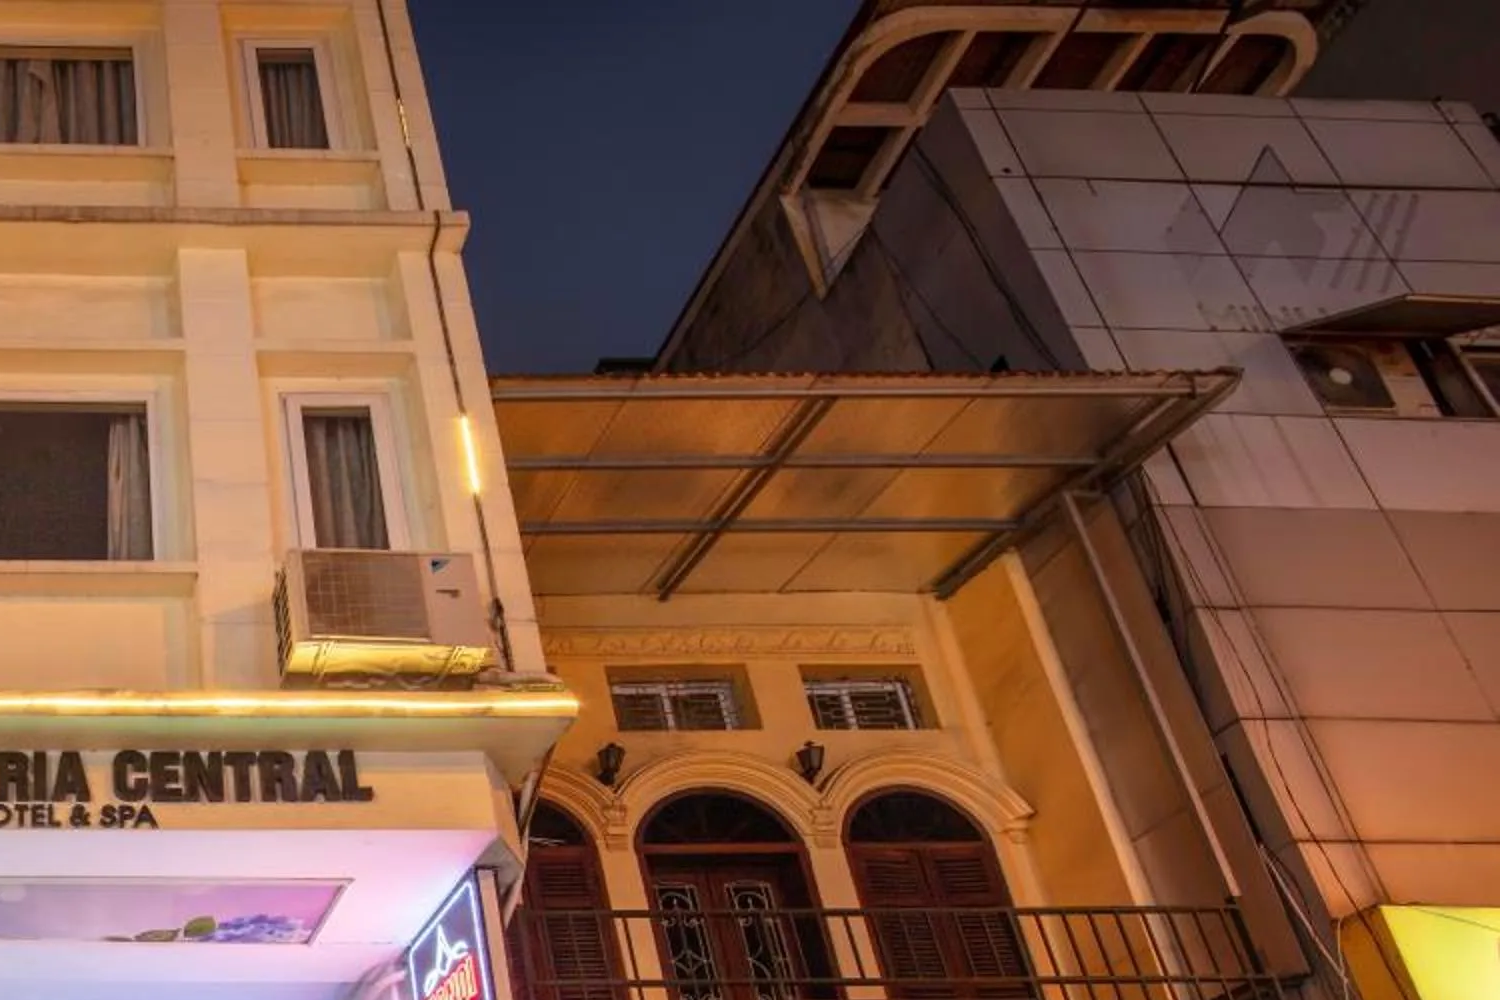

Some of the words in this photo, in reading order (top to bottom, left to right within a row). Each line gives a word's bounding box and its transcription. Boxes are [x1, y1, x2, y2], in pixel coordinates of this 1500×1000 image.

[113, 749, 374, 803] CENTRAL
[69, 805, 91, 828] &
[99, 804, 160, 828] SPA
